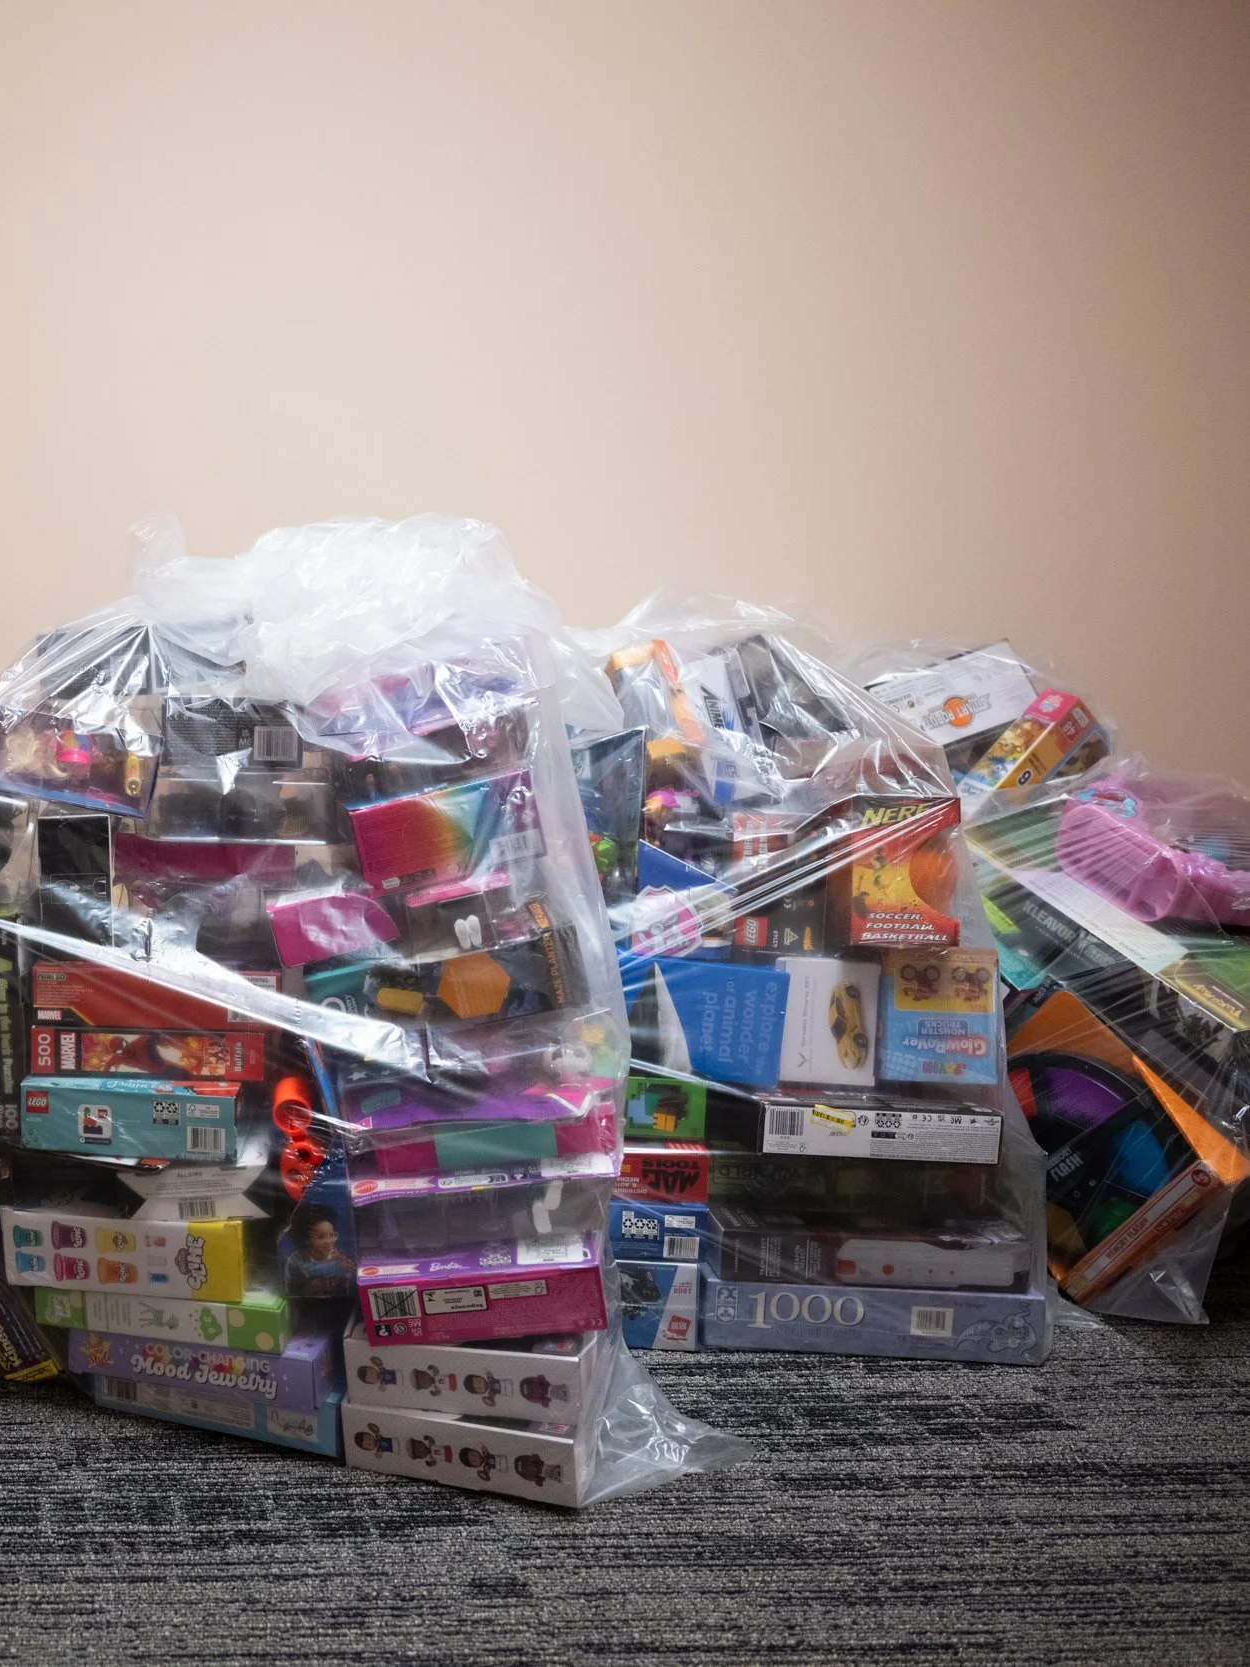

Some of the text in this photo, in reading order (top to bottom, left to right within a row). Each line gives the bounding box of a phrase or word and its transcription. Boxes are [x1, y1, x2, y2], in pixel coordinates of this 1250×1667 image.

[862, 803, 931, 826] NERF
[865, 922, 935, 932] FOOTBALL
[868, 912, 922, 922] SOCCER
[1023, 901, 1076, 945] KLEAVOR
[745, 919, 758, 946] LEGO
[860, 932, 948, 942] BASKETBALL
[38, 1010, 61, 1020] MARVEL
[699, 991, 718, 1054] planet
[719, 993, 733, 1064] animal
[739, 989, 757, 1059] wonder
[763, 981, 778, 1053] explore
[924, 1020, 961, 1028] TRUCKS
[921, 1027, 965, 1035] MONSTER
[38, 1034, 51, 1066] 500
[61, 1032, 76, 1071] MARVEL
[234, 1042, 243, 1072] Buffalo
[901, 1035, 986, 1056] GlowRover
[2, 1058, 14, 1094] Puzzles
[28, 1096, 48, 1108] LEGO
[5, 1104, 17, 1130] 100
[642, 1158, 699, 1169] TOOLS
[642, 1169, 700, 1195] MAC
[186, 1234, 207, 1290] SLIME
[430, 1261, 464, 1273] Barbie
[748, 1291, 865, 1330] 1000
[144, 1342, 271, 1374] COLOR-CHANGING
[130, 1354, 280, 1401] Mood Jewelry
